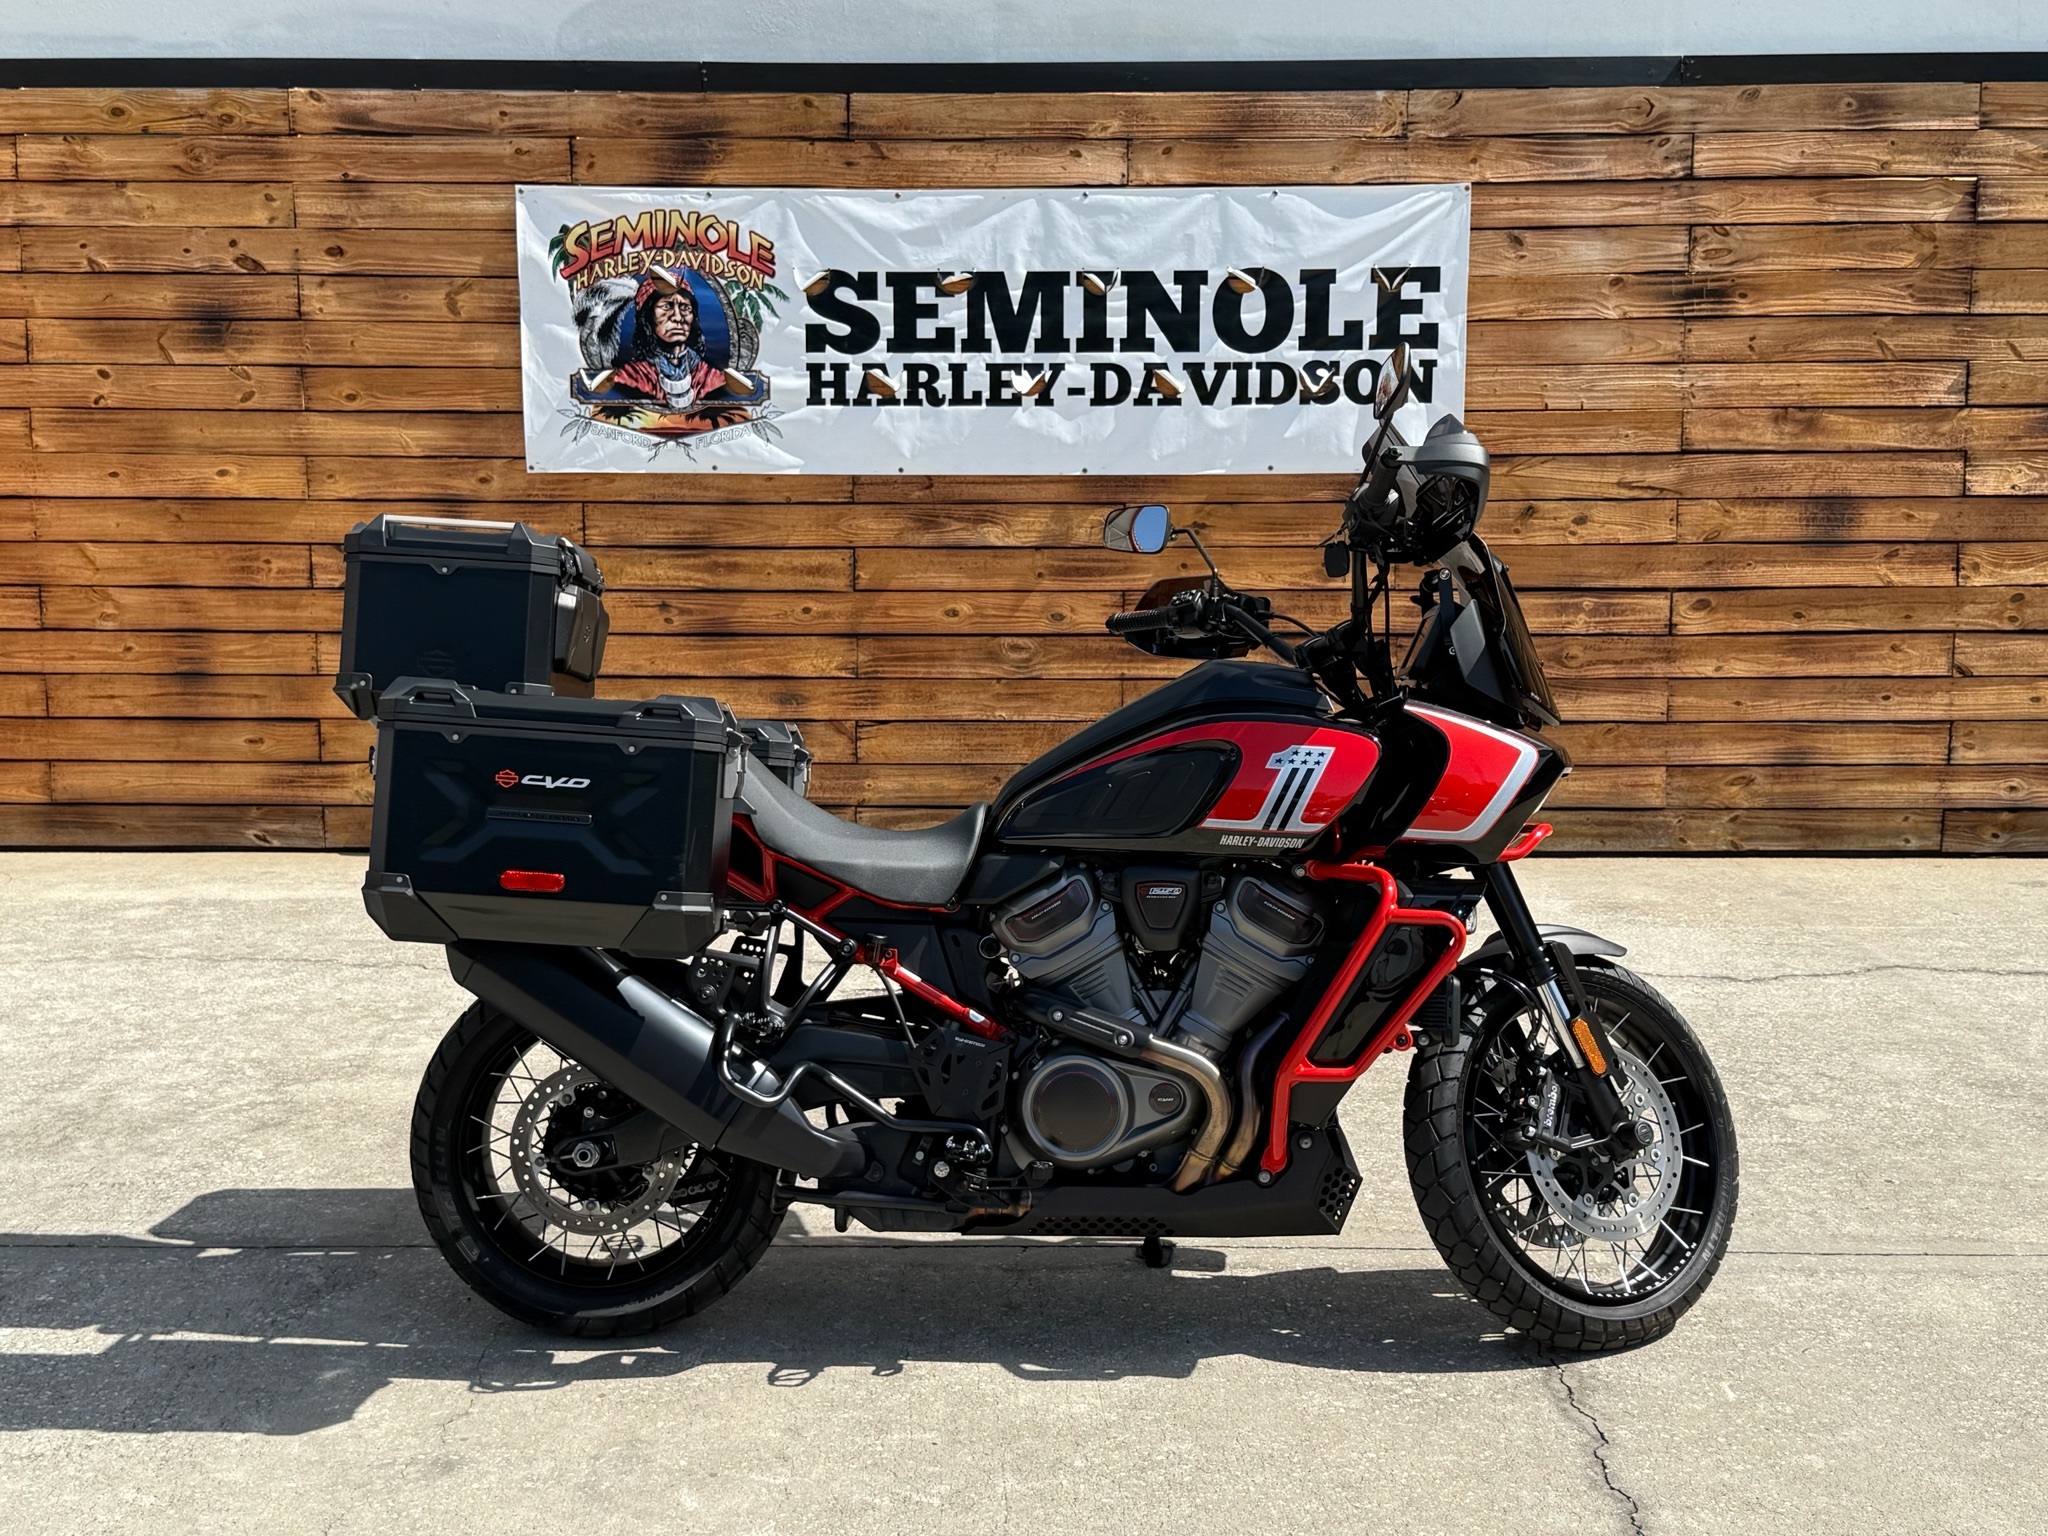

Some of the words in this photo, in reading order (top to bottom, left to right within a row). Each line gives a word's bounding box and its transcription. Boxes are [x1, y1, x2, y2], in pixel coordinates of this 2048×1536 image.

[560, 209, 776, 279] SEMINOLE
[576, 249, 765, 290] HARLEY-DAVIDSON
[804, 266, 1441, 354] SEMINOLE
[695, 425, 751, 449] FLORIDA
[521, 774, 591, 789] CVO
[1219, 834, 1305, 849] HARLEY-DAVIDSON
[1543, 1085, 1558, 1127] brembo
